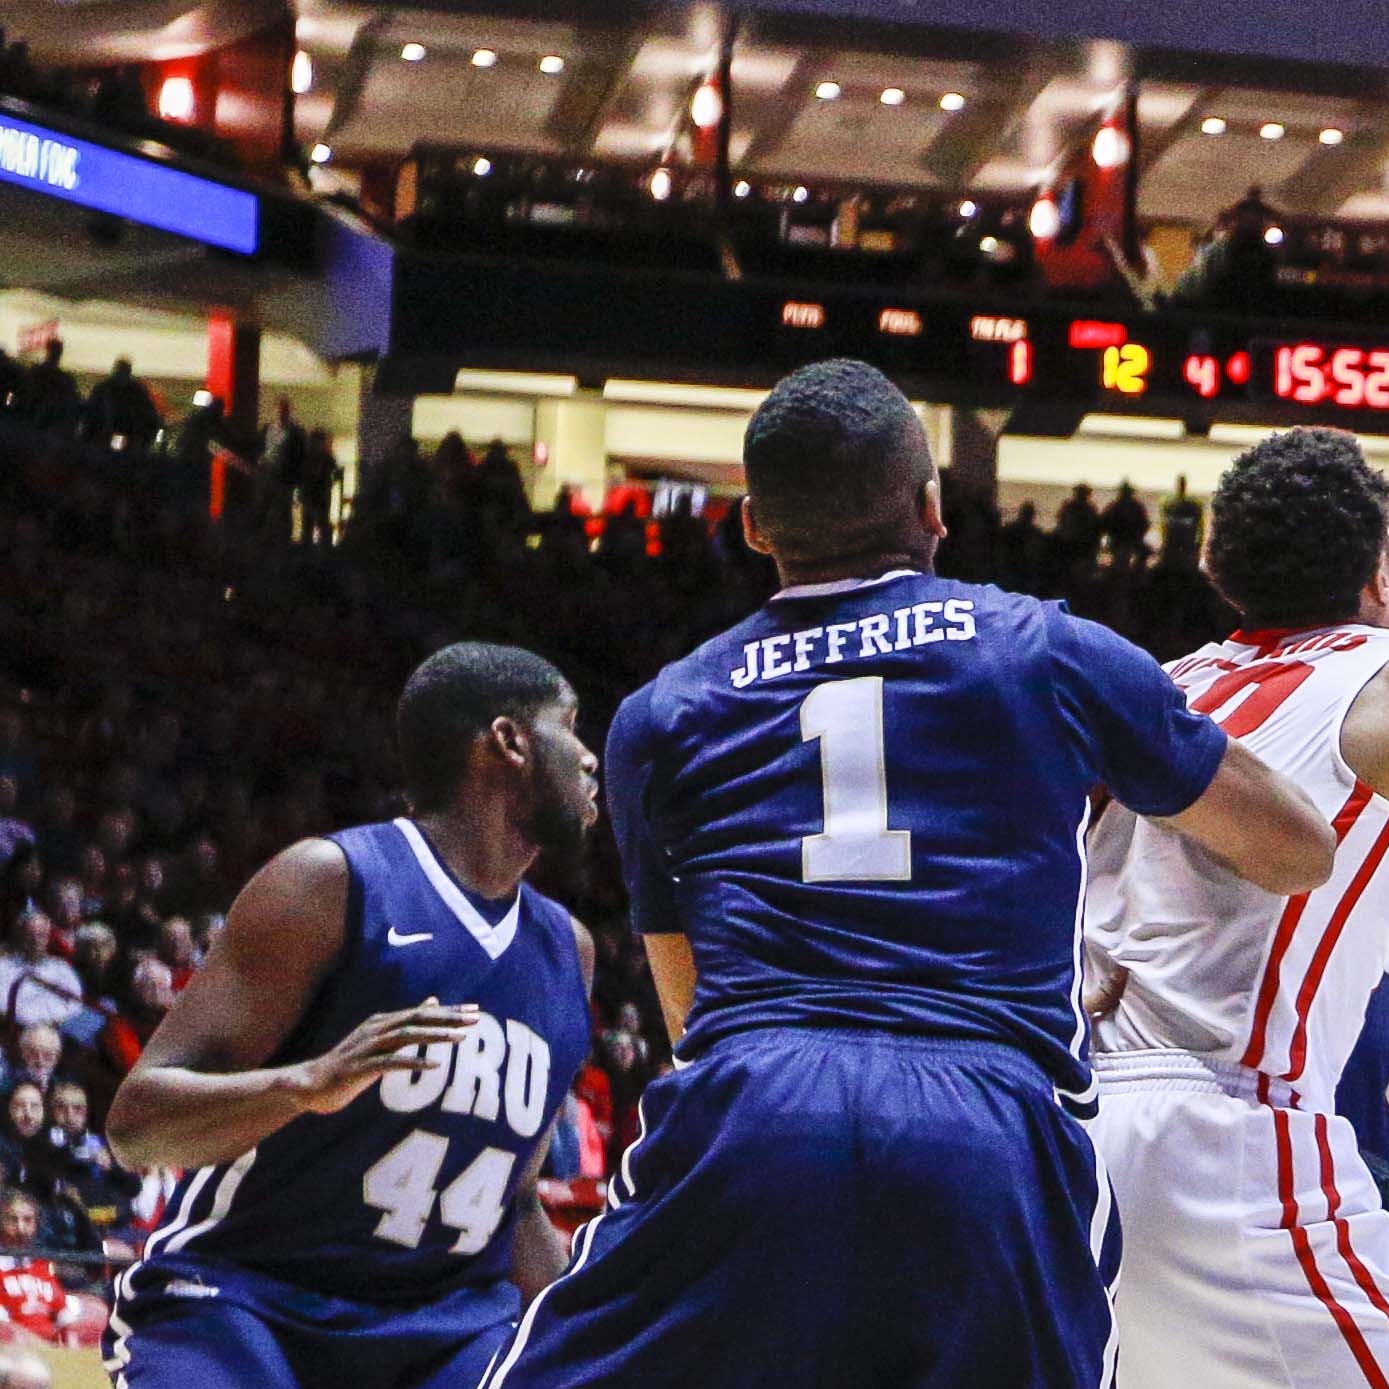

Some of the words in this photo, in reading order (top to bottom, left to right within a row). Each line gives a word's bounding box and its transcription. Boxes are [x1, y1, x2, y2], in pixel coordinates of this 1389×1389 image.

[1101, 342, 1151, 396] 12
[729, 598, 977, 690] JEFFRIES
[799, 675, 912, 884] 1
[362, 1127, 517, 1256] 44
